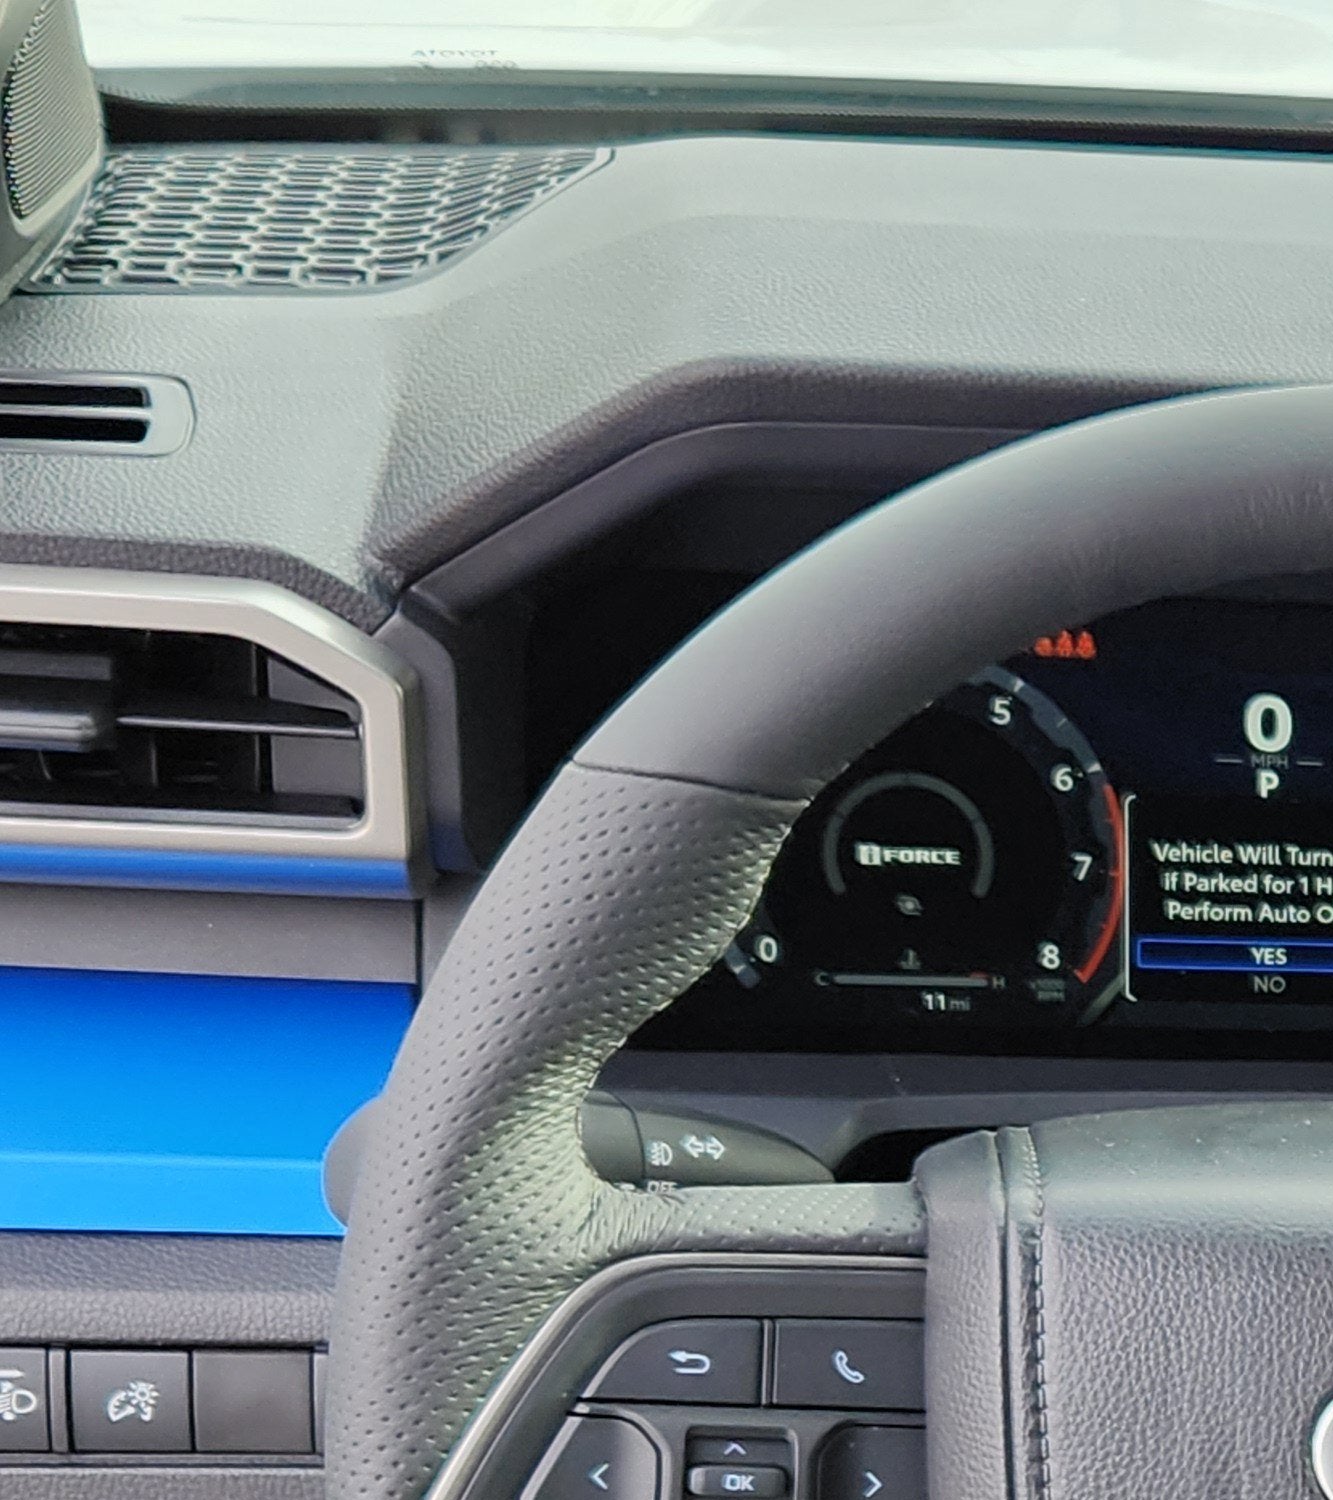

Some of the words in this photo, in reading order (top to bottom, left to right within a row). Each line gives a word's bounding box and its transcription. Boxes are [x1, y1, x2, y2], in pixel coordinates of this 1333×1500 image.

[989, 700, 1012, 726] 5
[1241, 694, 1293, 753] 0
[1050, 766, 1073, 793] 6
[1256, 770, 1279, 799] P
[1152, 842, 1233, 864] Vehicle
[1236, 844, 1282, 866] Will
[1287, 849, 1333, 867] Turn
[1071, 853, 1094, 882] 7
[1183, 872, 1257, 894] Parked
[1263, 875, 1294, 894] for
[1299, 877, 1310, 894] 1
[1164, 901, 1252, 923] Perform
[1258, 904, 1311, 923] Auto
[757, 936, 779, 964] 0
[1038, 945, 1062, 971] 8
[1250, 948, 1288, 967] YES
[1253, 975, 1286, 993] NO
[922, 993, 947, 1012] 11
[948, 997, 972, 1012] mi
[721, 1474, 755, 1492] OK
